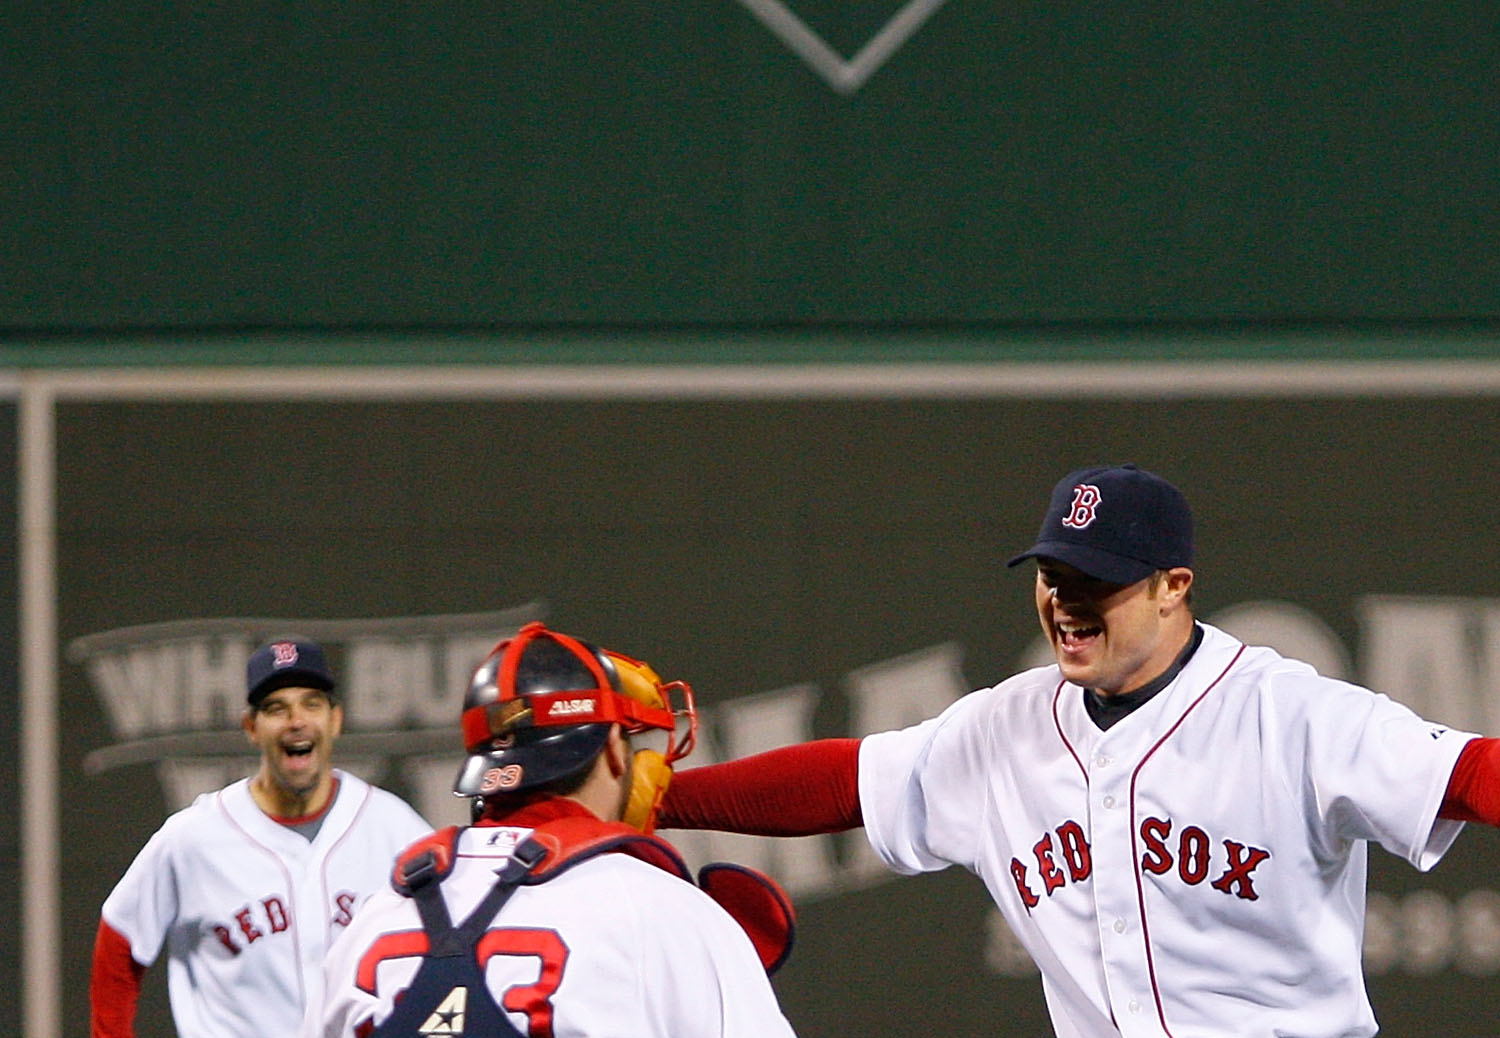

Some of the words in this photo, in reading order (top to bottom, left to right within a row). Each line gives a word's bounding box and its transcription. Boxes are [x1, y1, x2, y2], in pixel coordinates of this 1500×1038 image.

[1062, 484, 1102, 529] B
[88, 638, 250, 736] WH
[271, 640, 299, 669] B
[1010, 819, 1092, 917] RED
[1139, 816, 1271, 901] SOX
